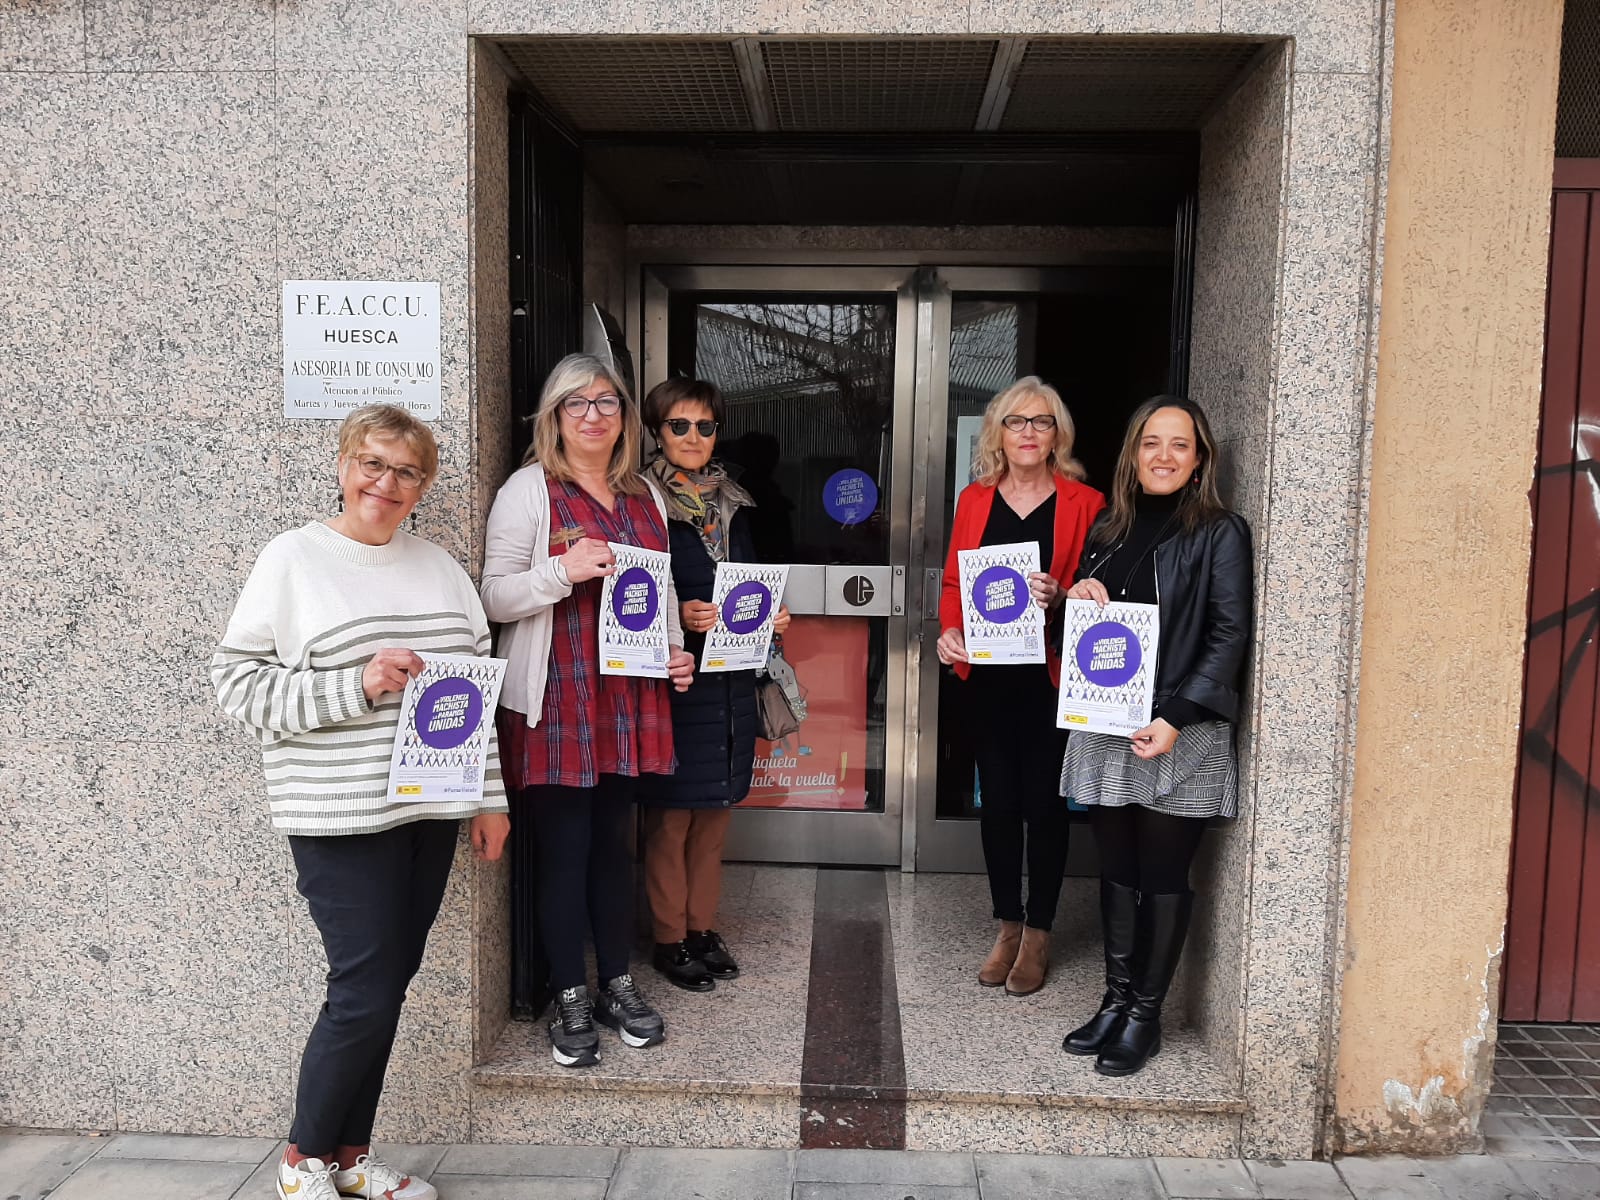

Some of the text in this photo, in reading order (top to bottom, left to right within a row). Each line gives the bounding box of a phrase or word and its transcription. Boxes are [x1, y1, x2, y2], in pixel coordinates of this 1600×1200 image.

[296, 294, 427, 317] F.E.A.C.C.U.
[324, 329, 398, 344] HUESCA
[292, 360, 434, 378] ASESORIA DE CONSUMO
[361, 386, 369, 395] al
[293, 400, 321, 408] Martes
[333, 400, 359, 409] Jueves
[408, 401, 431, 410] Horas
[836, 494, 863, 506] UNIDAS
[622, 602, 648, 615] UNIDAS
[985, 595, 1015, 611] UNIDAS
[732, 609, 759, 622] UNIDAS
[1092, 643, 1127, 653] MACHISTA
[1090, 657, 1126, 671] UNIDAS
[432, 700, 469, 713] MACHISTA
[428, 716, 466, 732] UNIDAS
[778, 772, 791, 787] la
[795, 771, 836, 786] vuelta
